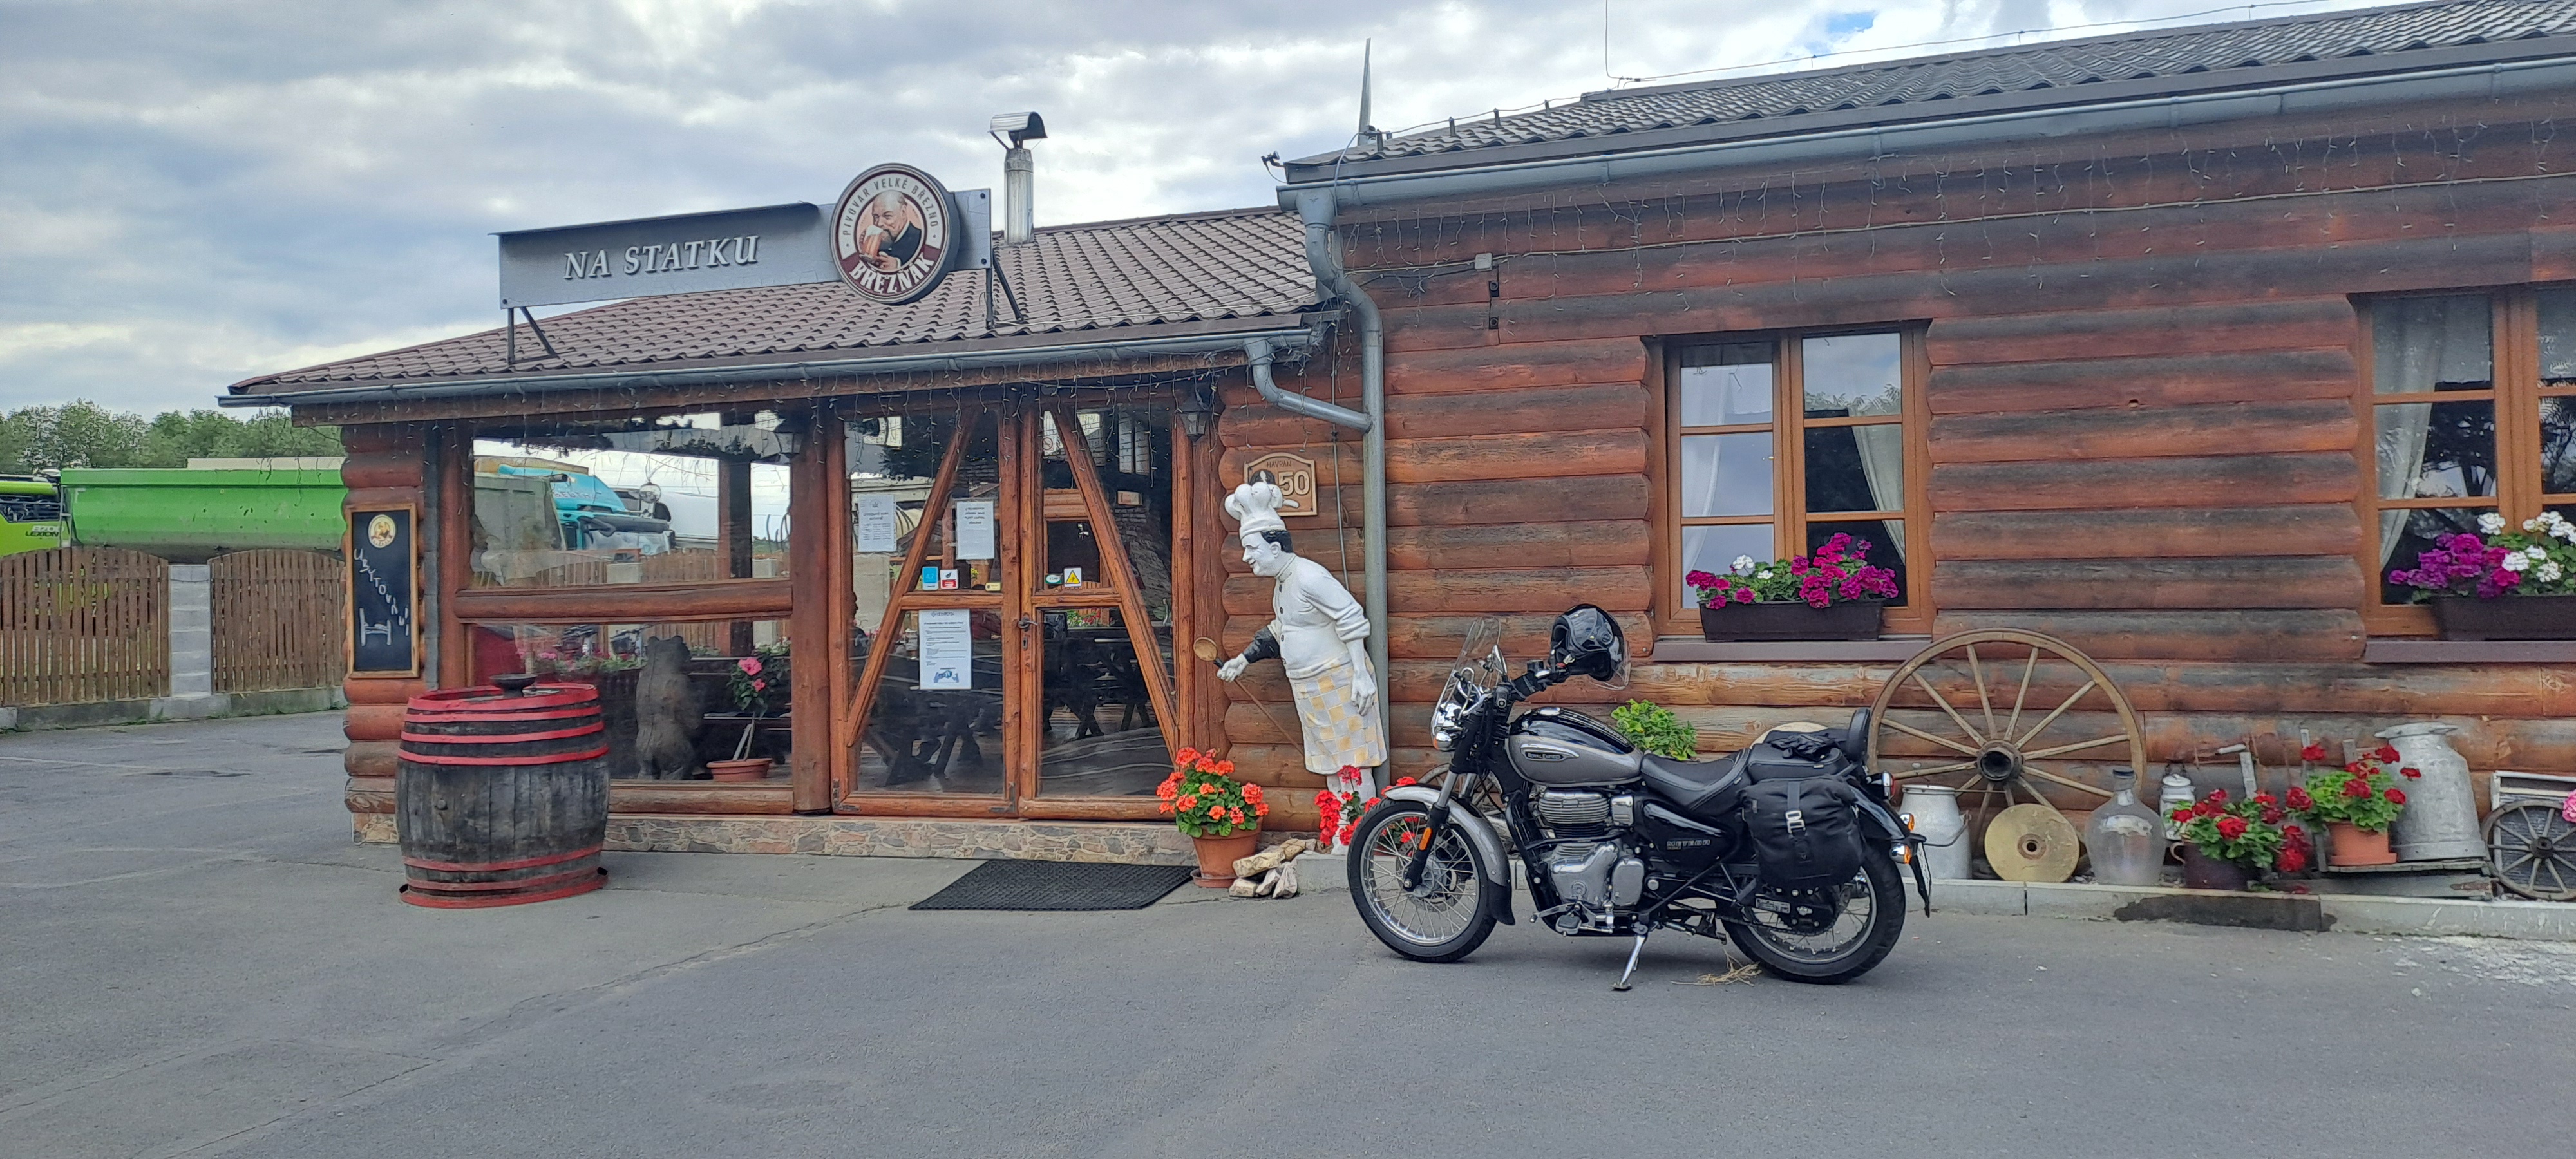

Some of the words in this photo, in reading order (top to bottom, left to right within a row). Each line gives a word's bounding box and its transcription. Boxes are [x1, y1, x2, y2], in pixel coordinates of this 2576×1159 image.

[842, 187, 871, 236] PIVOVAR
[873, 176, 909, 191] VELKÉ
[911, 184, 939, 227] BŘEZNO
[563, 249, 611, 280] NA
[623, 234, 759, 275] STATKU
[849, 252, 935, 294] BŘEZŇÁK
[1278, 470, 1310, 496] 50
